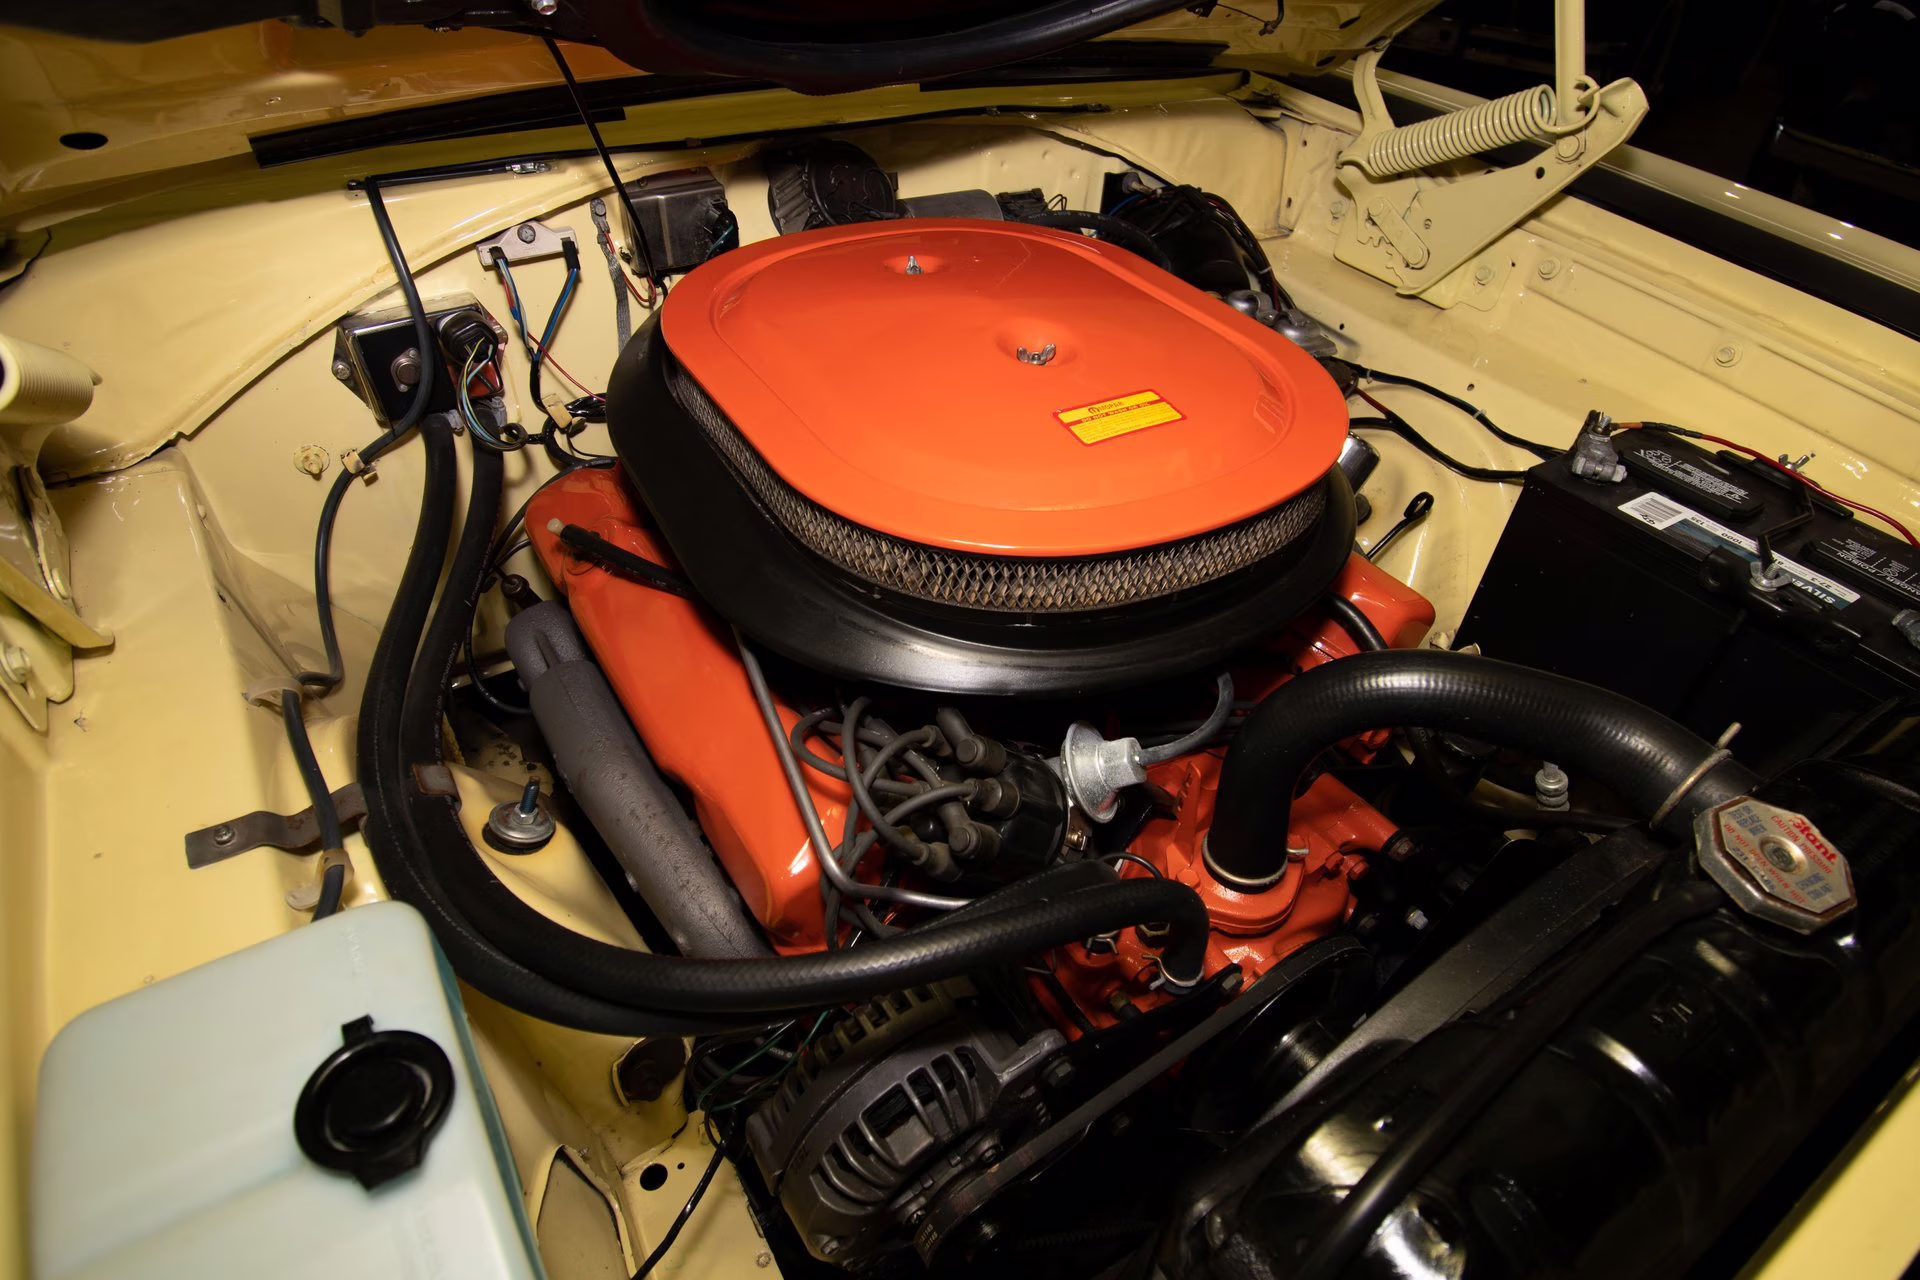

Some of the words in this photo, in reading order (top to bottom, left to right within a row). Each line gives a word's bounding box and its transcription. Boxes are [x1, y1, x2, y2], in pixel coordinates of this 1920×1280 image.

[1837, 551, 1877, 573] POISON
[1791, 578, 1836, 604] SILVE
[1886, 576, 1920, 597] ANGER
[1771, 815, 1800, 842] CAUTION
